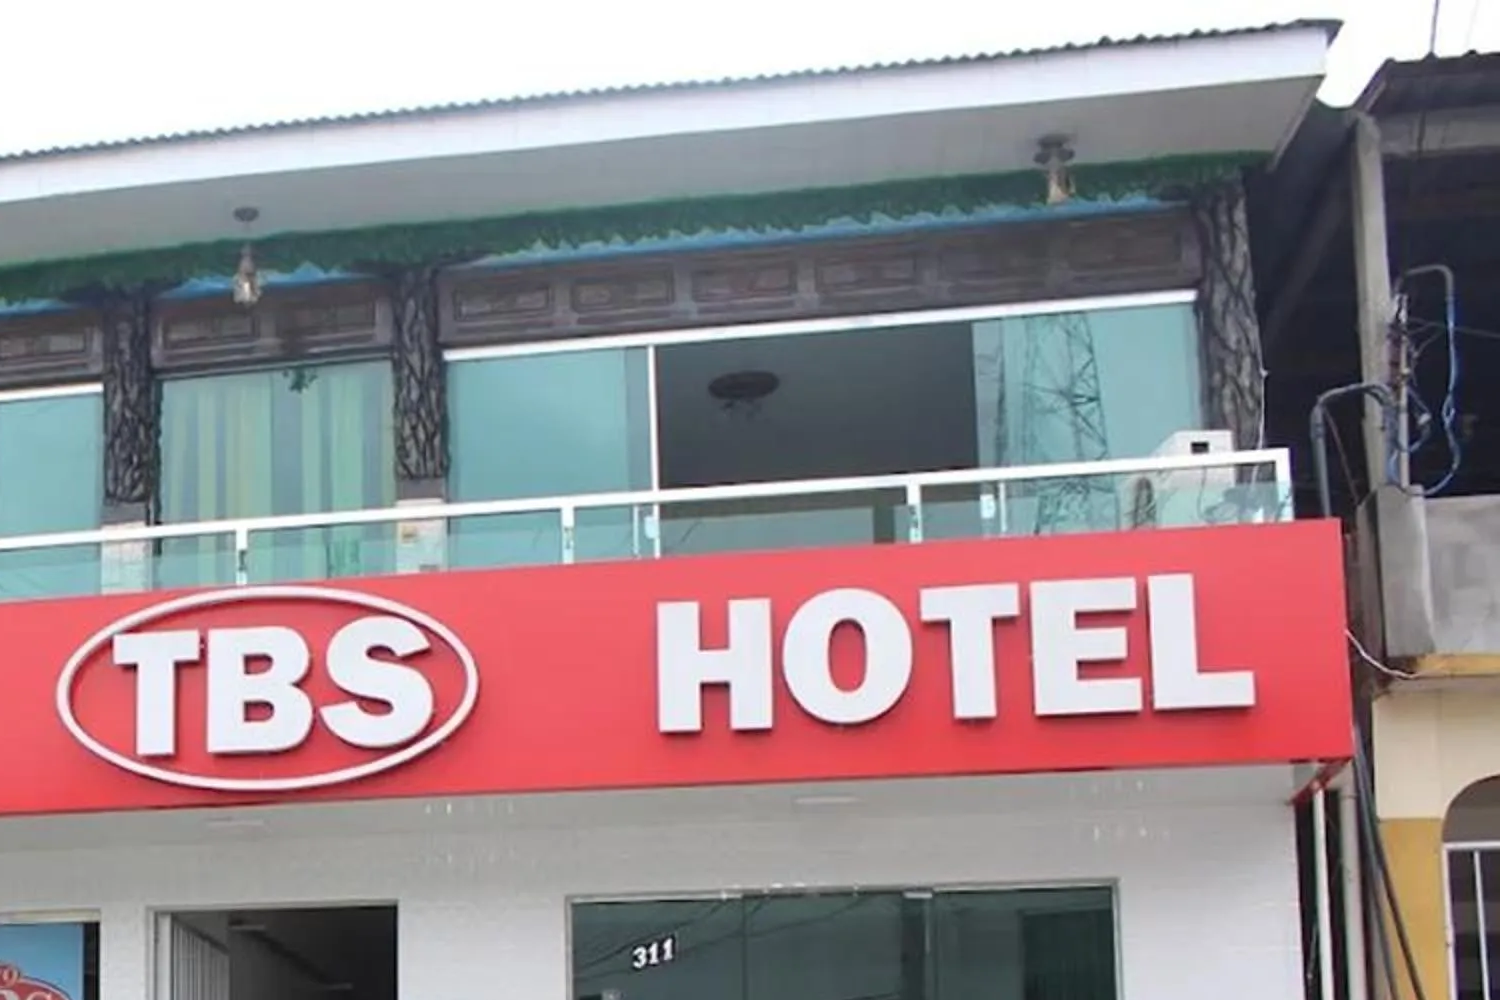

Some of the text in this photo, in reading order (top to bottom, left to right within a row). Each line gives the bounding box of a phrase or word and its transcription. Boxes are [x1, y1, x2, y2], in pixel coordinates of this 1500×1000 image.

[113, 573, 1256, 756] TBS HOTEL
[632, 938, 673, 969] 311
